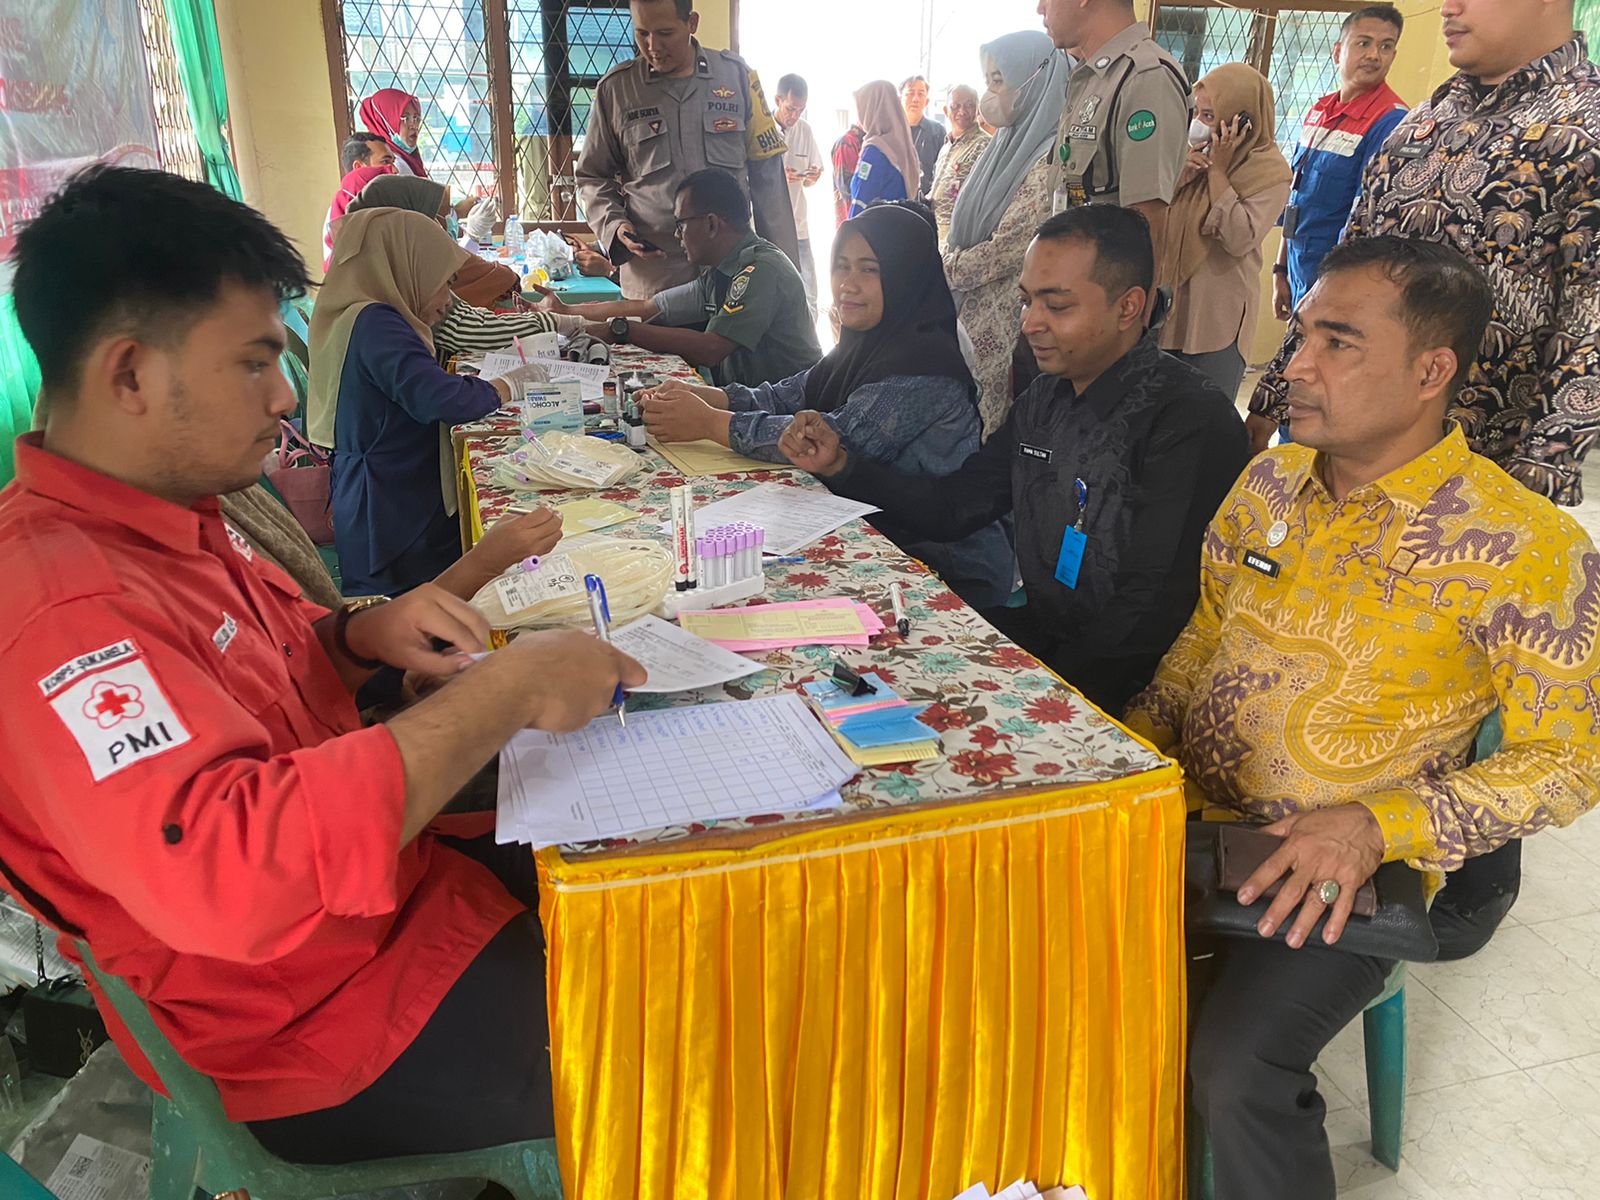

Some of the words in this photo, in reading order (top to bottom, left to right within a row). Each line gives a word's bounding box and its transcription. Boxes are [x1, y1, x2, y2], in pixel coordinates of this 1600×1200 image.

[708, 101, 739, 113] POLRI
[43, 664, 75, 691] KORPS
[76, 642, 133, 671] SUKARELA
[108, 721, 173, 765] PMI
